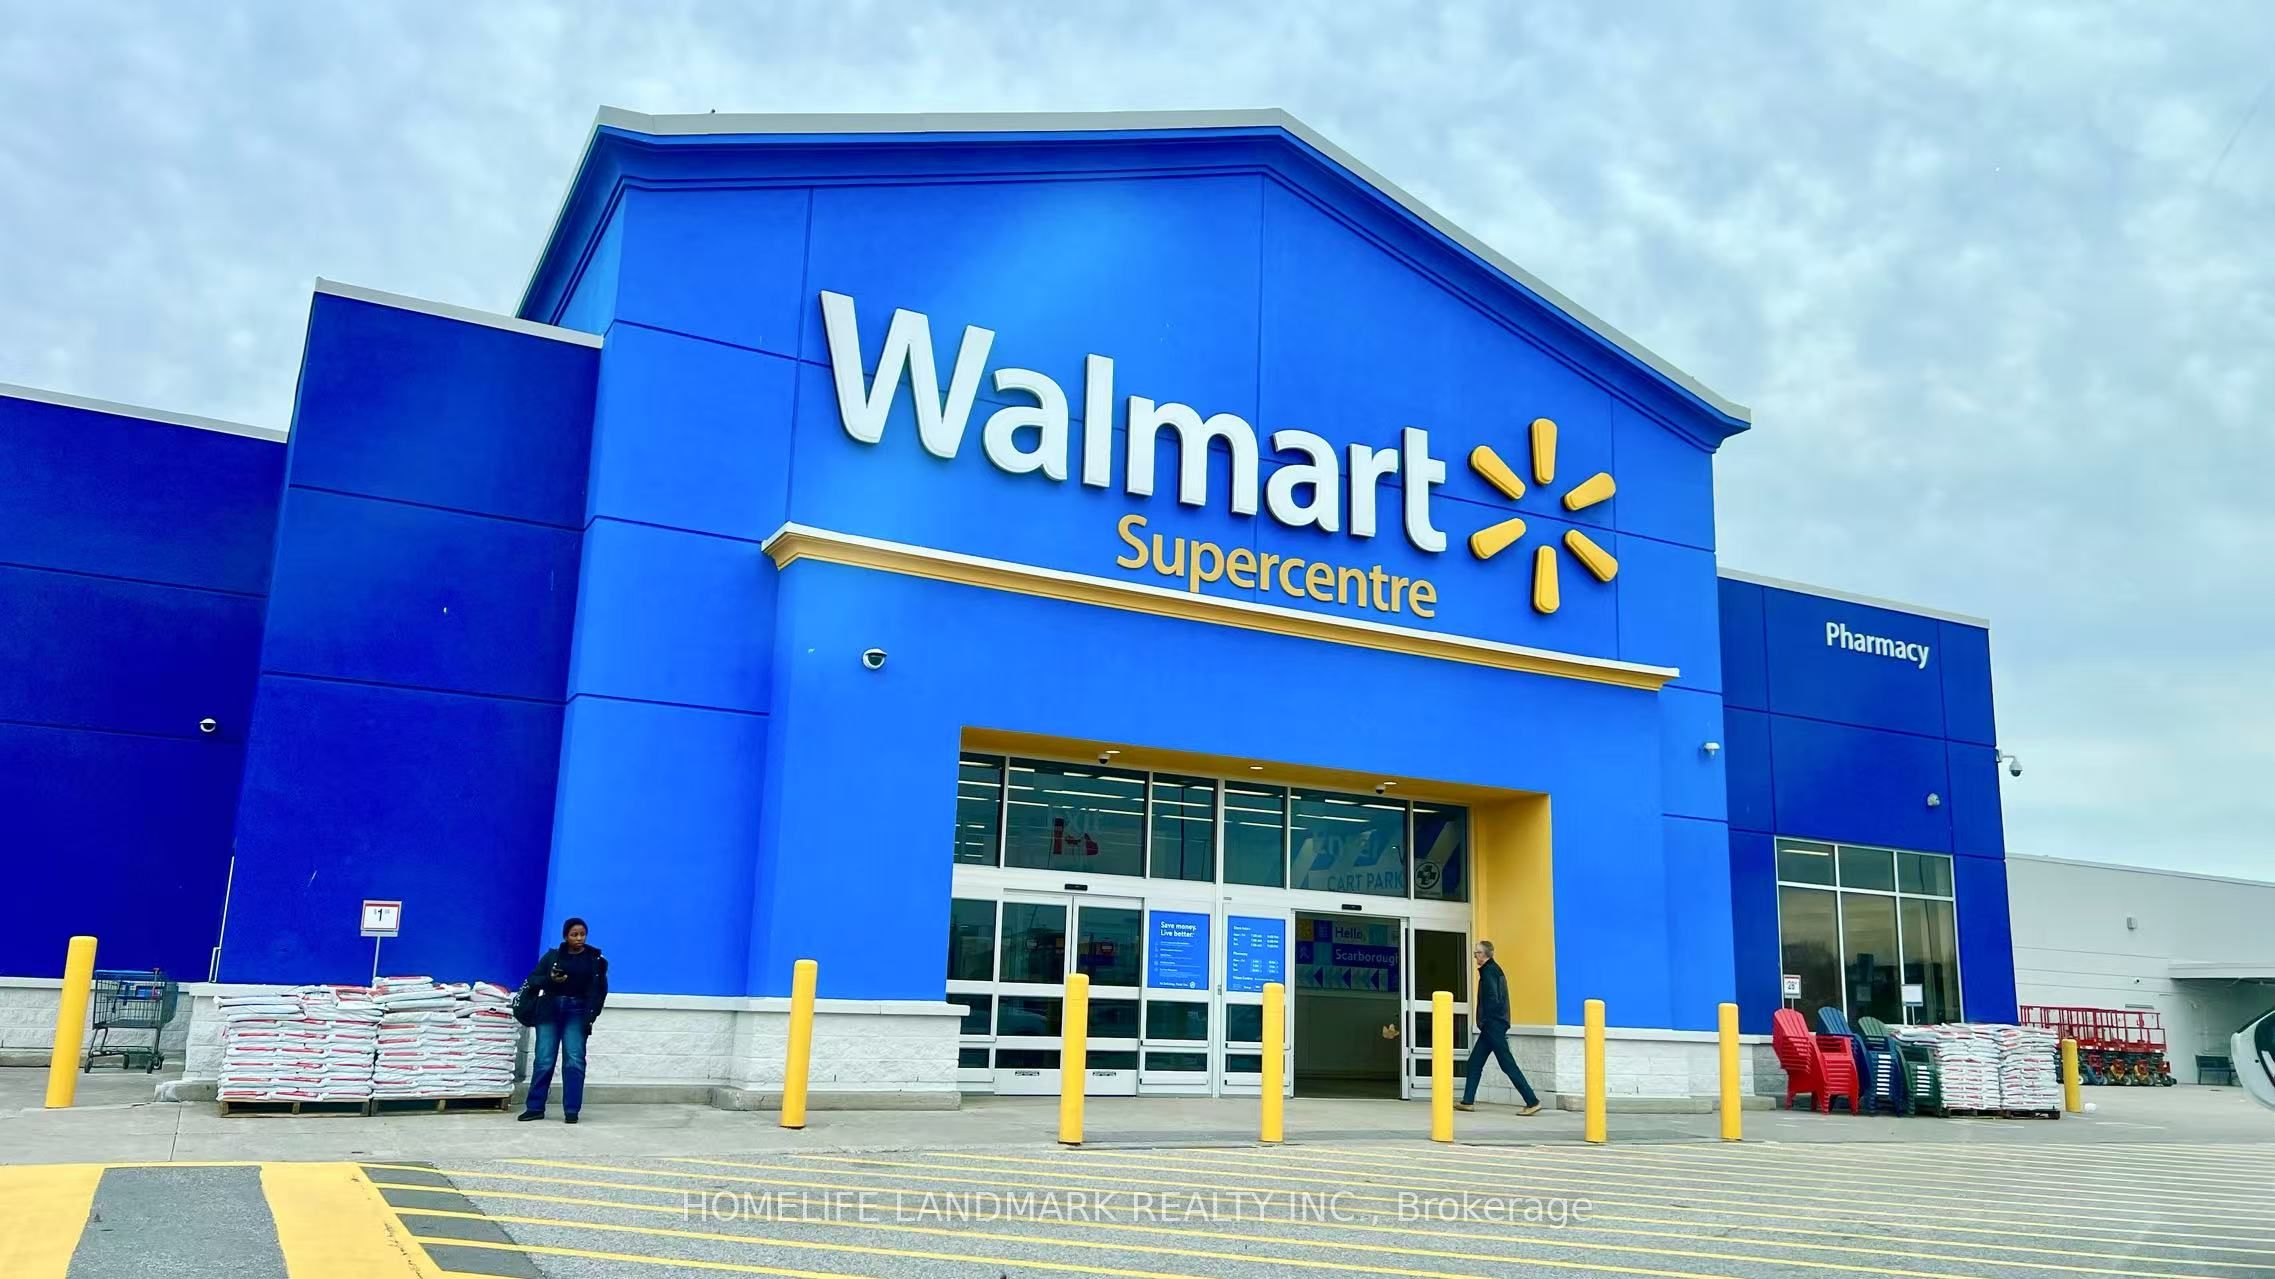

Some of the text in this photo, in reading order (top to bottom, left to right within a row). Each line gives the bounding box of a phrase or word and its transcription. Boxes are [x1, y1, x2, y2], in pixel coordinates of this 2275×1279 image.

[818, 290, 1448, 552] Walmart
[1116, 513, 1438, 618] Supercentre
[1825, 621, 1930, 670] Pharmacy
[1327, 873, 1364, 892] CART
[1160, 920, 1197, 932] Save money.
[1160, 929, 1173, 937] Live
